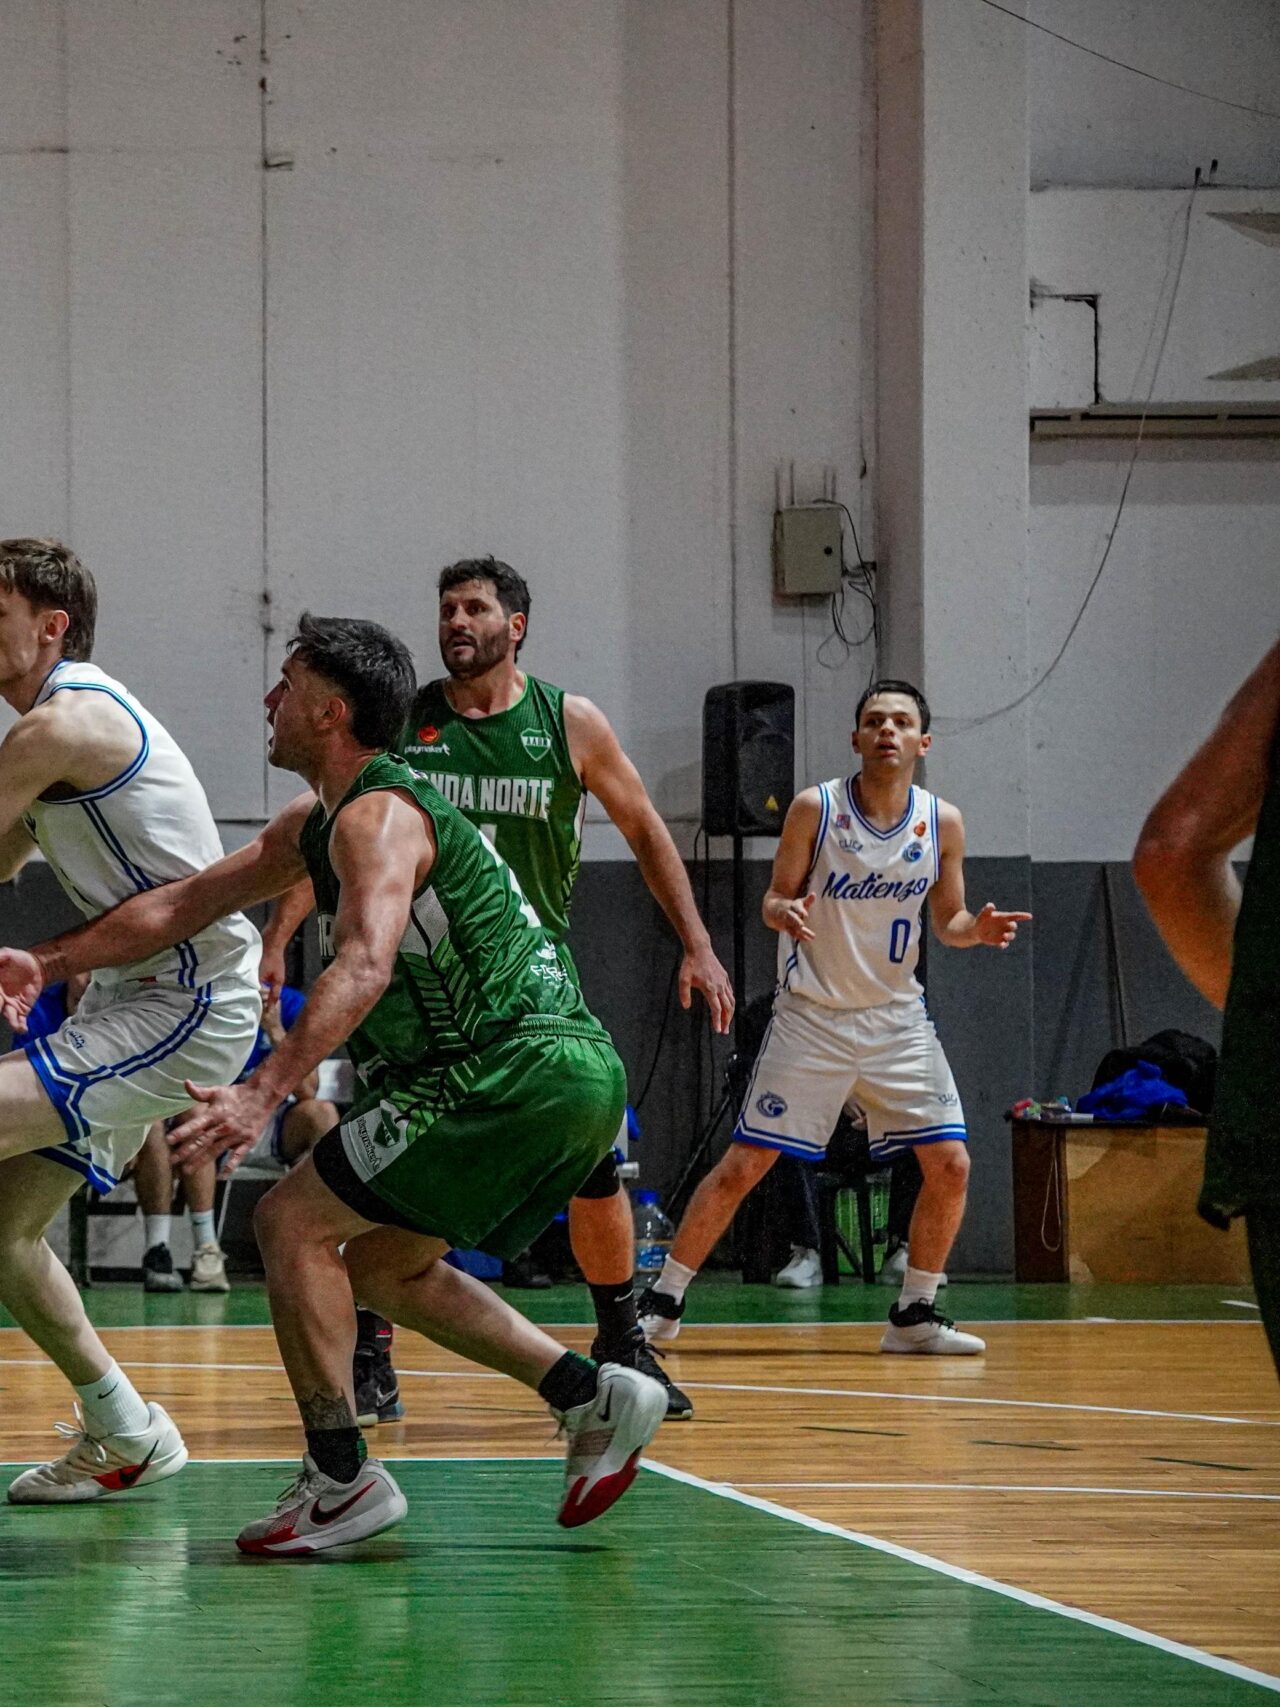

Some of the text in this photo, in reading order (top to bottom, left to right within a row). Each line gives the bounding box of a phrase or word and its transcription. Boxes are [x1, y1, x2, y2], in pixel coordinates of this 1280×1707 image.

[430, 773, 554, 822] NDA NORTE
[821, 871, 928, 902] Matienzo
[889, 918, 911, 964] 0
